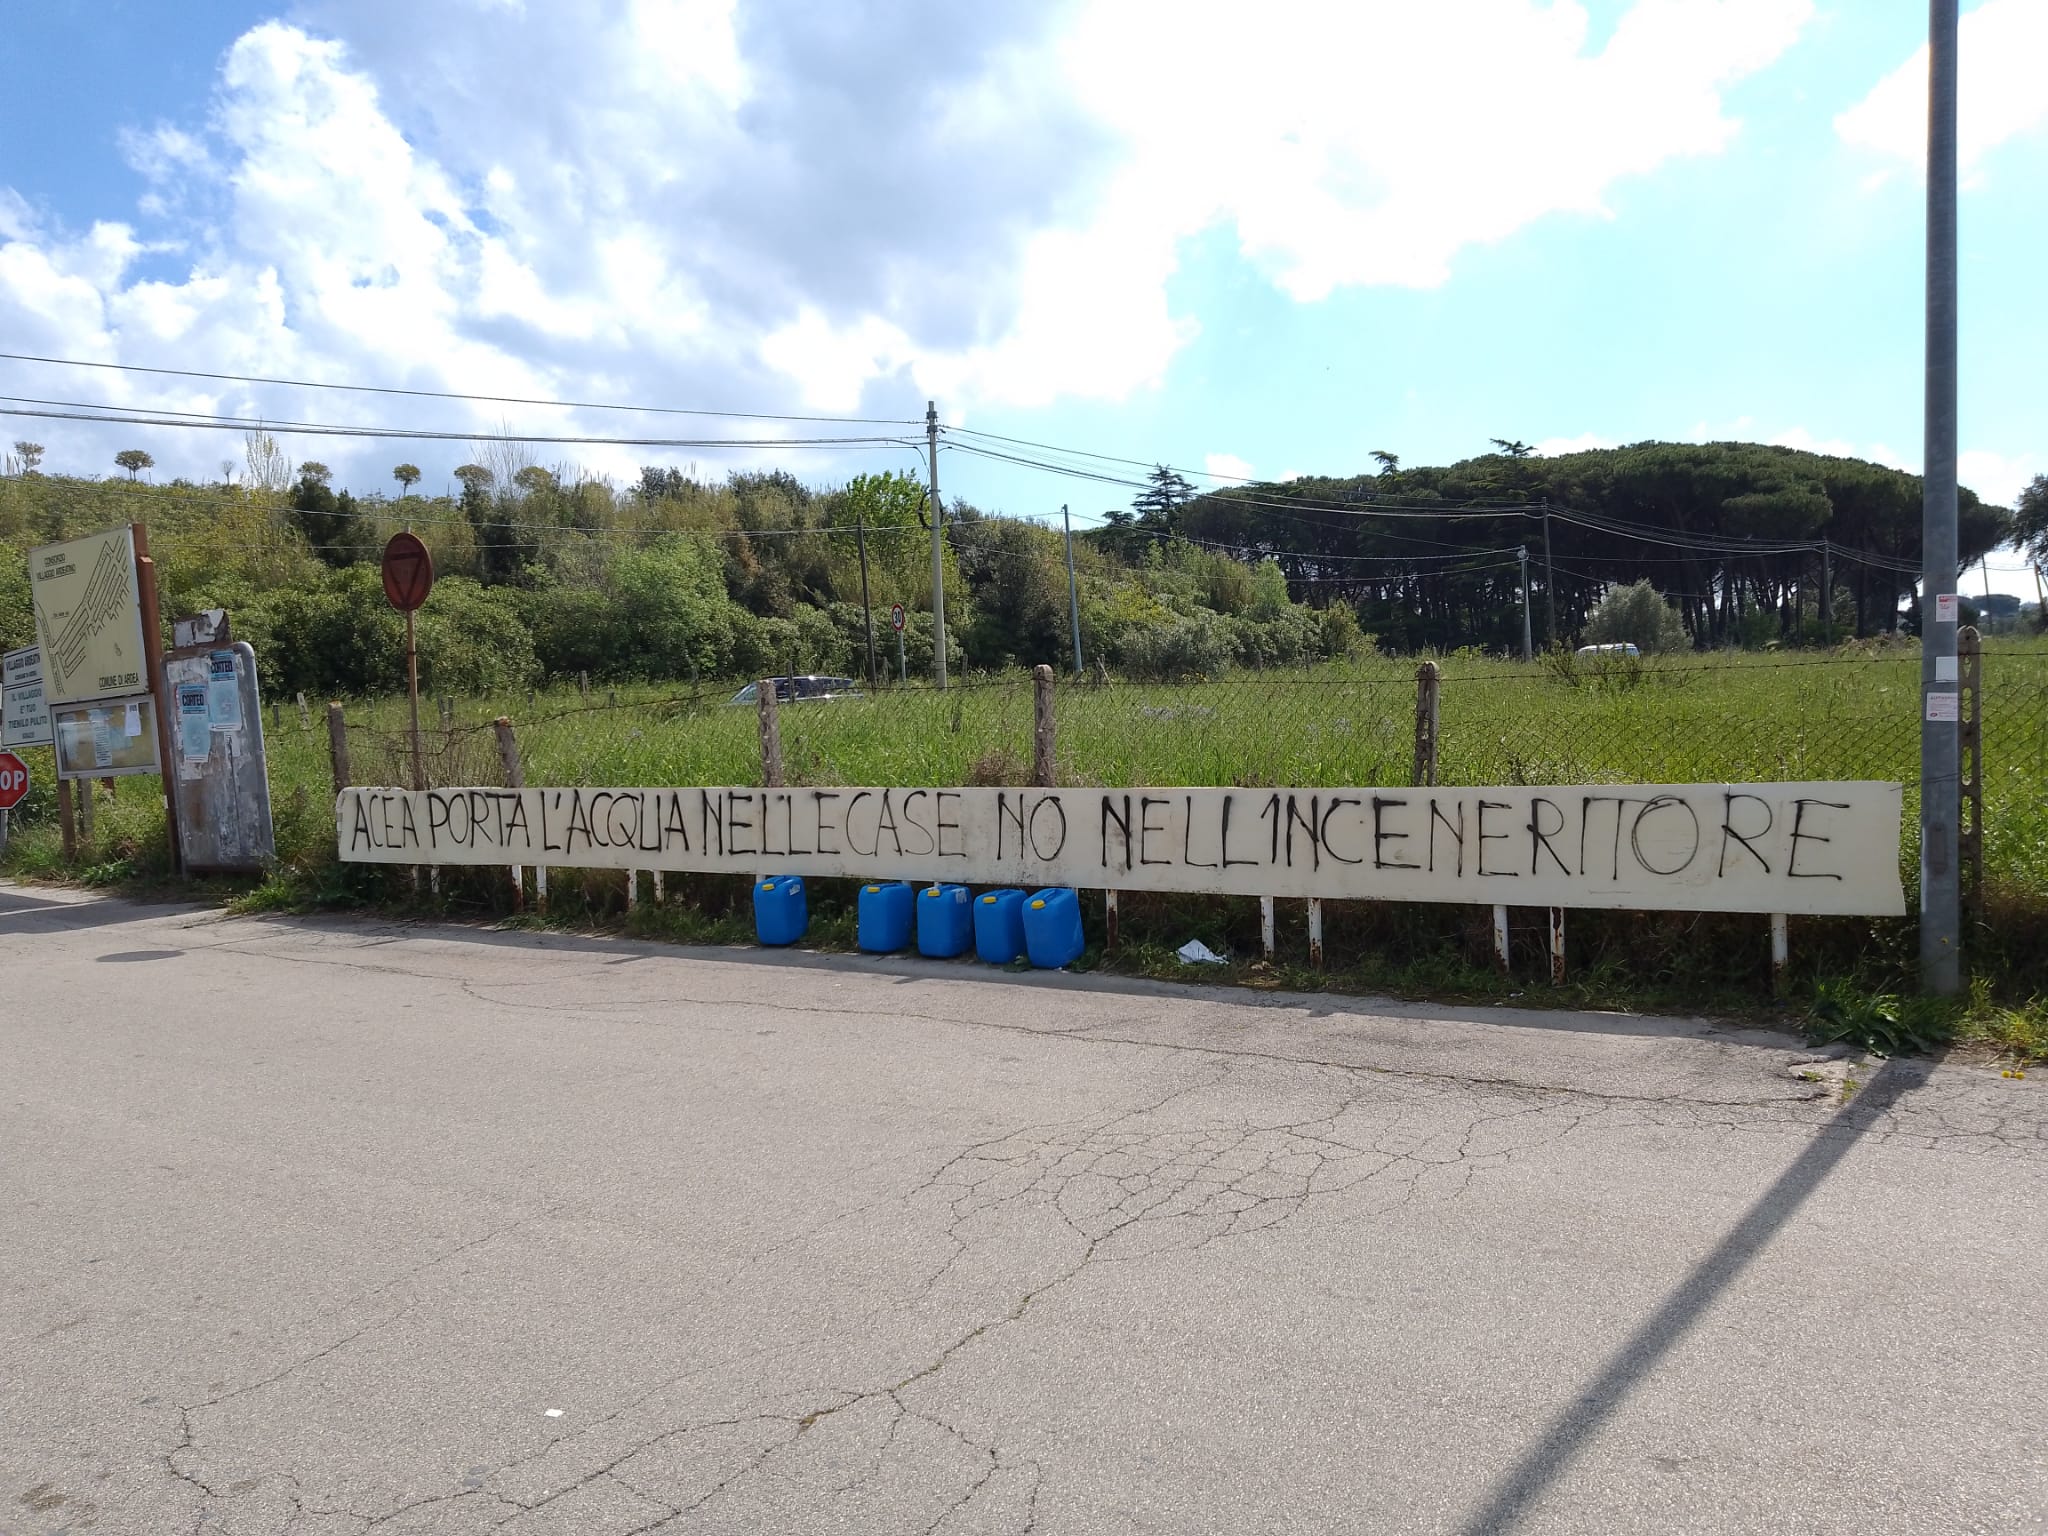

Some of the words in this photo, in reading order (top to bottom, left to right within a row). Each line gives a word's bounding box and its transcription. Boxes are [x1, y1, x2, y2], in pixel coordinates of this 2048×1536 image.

[24, 653, 41, 667] ARDEATIN
[98, 675, 118, 688] COMUNE
[124, 672, 139, 684] ARDEA
[18, 688, 42, 701] VILLAGGIO
[182, 693, 205, 707] CORTEO
[0, 770, 25, 790] OP
[351, 793, 419, 852] ACEA
[427, 791, 530, 849] PORTA
[540, 789, 690, 854] L'ACQUA
[845, 788, 967, 857] CASE
[996, 792, 1067, 861] NO
